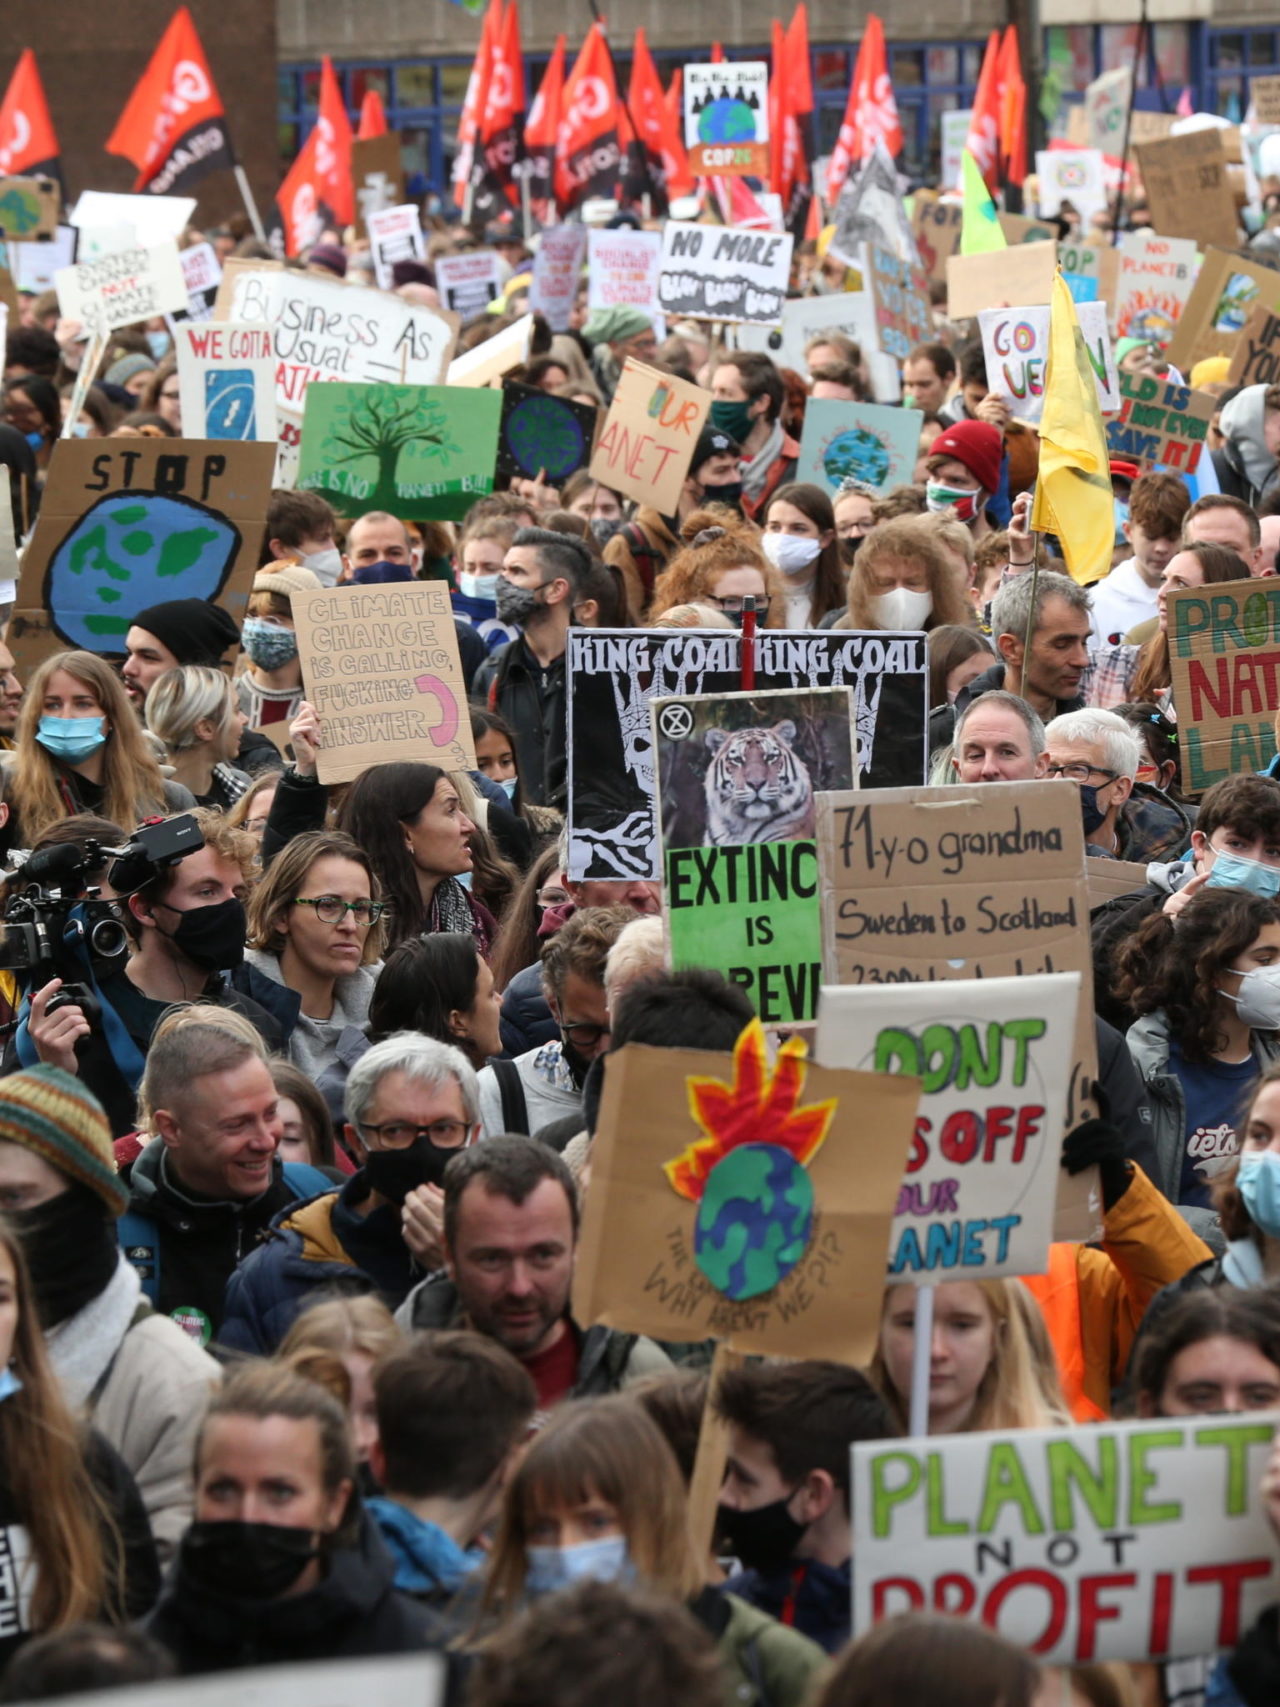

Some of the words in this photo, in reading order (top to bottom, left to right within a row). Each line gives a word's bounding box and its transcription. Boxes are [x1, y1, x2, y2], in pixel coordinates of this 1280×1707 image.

[670, 231, 704, 257] NO
[714, 233, 783, 268] MORE
[1145, 242, 1170, 256] NO
[187, 329, 223, 359] WE
[230, 330, 271, 359] GOTTA
[994, 320, 1036, 357] GO
[1163, 384, 1191, 411] IS
[596, 420, 679, 486] ANET
[85, 451, 226, 502] STOP
[311, 620, 439, 652] CHANGE
[571, 636, 650, 676] KING
[756, 637, 829, 677] KING
[841, 639, 927, 675] COAL
[318, 709, 429, 750] ANSWER
[942, 804, 1063, 875] grandma
[668, 843, 817, 910] EXTINC
[745, 914, 774, 947] IS
[834, 898, 938, 941] Sweden
[942, 898, 966, 936] to
[976, 895, 1078, 935] Scotland
[939, 1105, 1046, 1165] OFF
[888, 1214, 1023, 1273] ANET
[870, 1424, 1275, 1539] PLANET
[976, 1533, 1138, 1575] NOT
